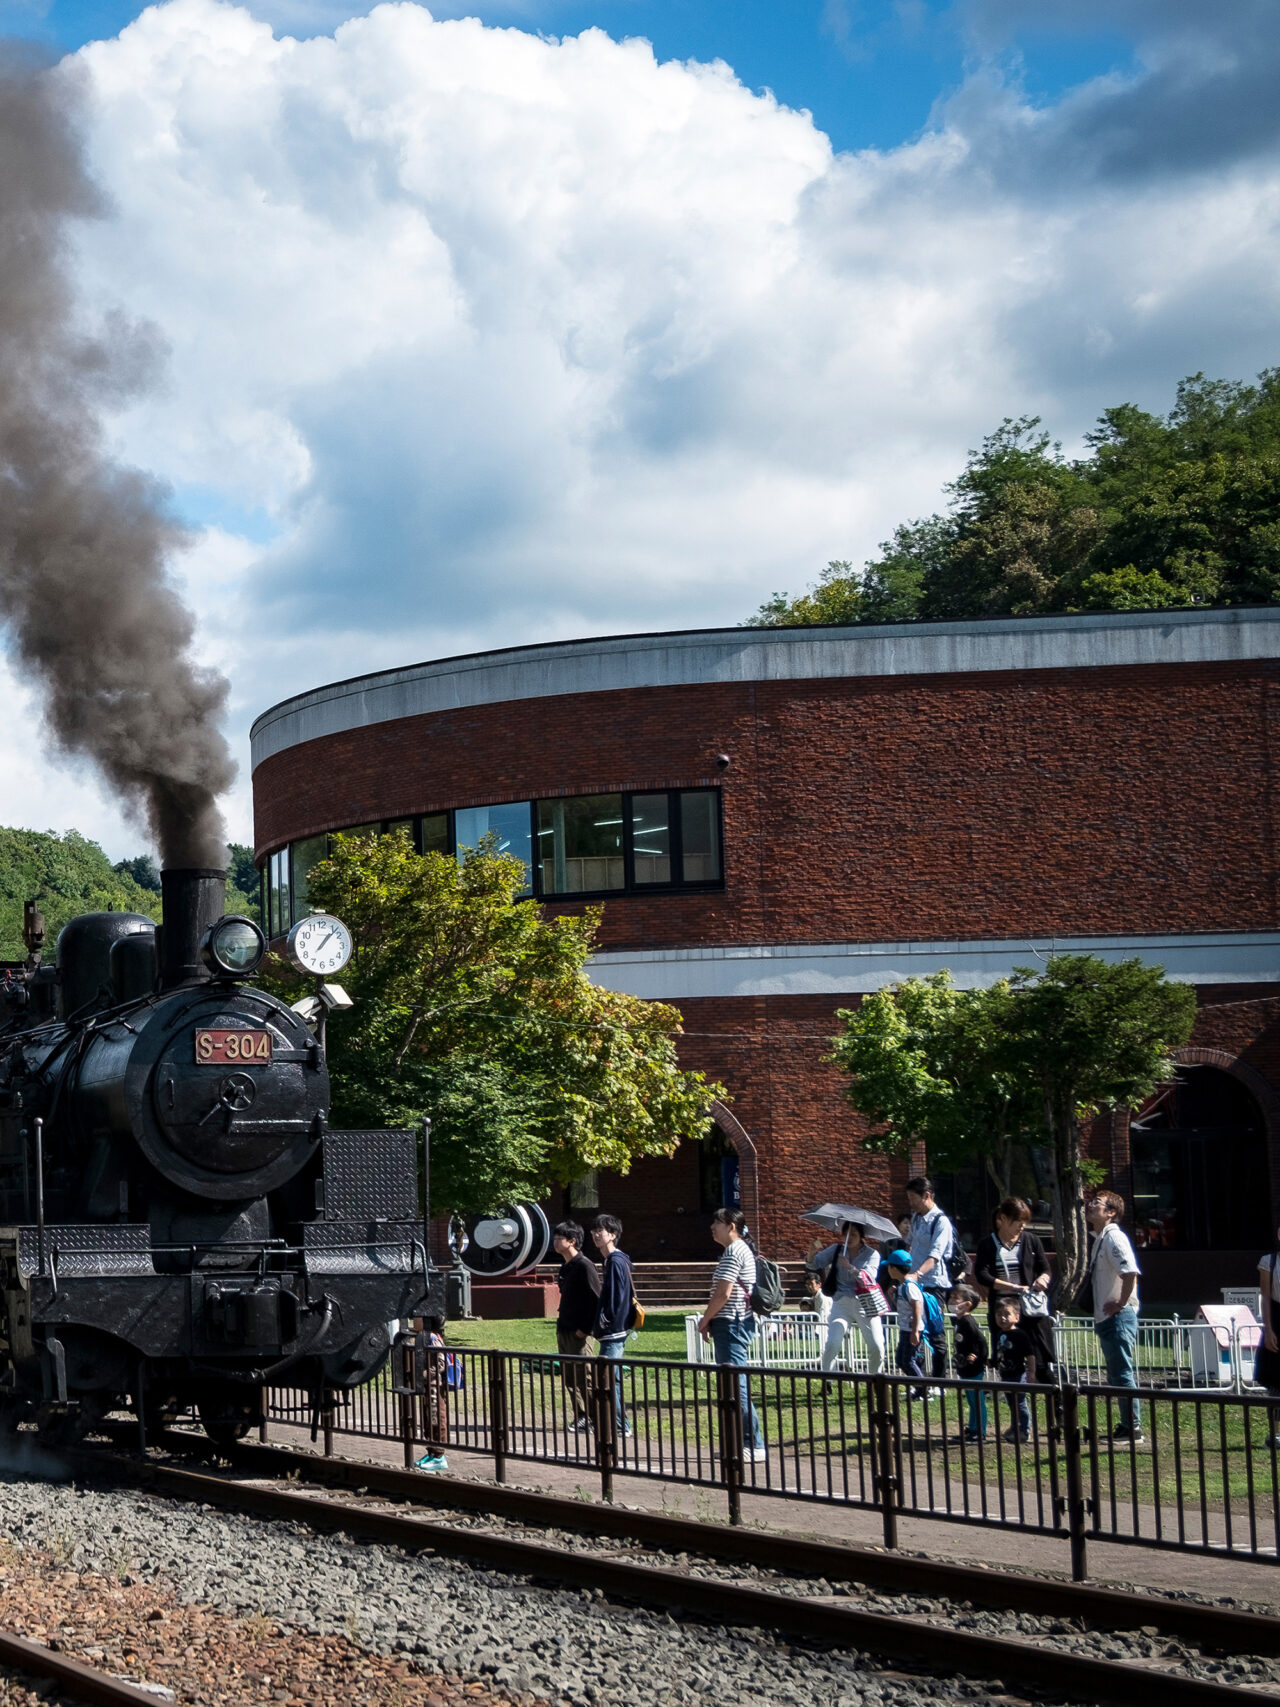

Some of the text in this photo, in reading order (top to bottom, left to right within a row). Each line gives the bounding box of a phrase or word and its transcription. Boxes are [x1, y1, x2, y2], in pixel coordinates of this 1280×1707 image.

[317, 920, 327, 929] 12
[302, 931, 311, 939] 10
[336, 931, 342, 939] 2
[300, 941, 306, 949] 9
[339, 941, 345, 950] 3
[303, 951, 309, 959] 8
[311, 958, 317, 966] 7
[319, 961, 326, 969] 6
[200, 1033, 270, 1058] S-304
